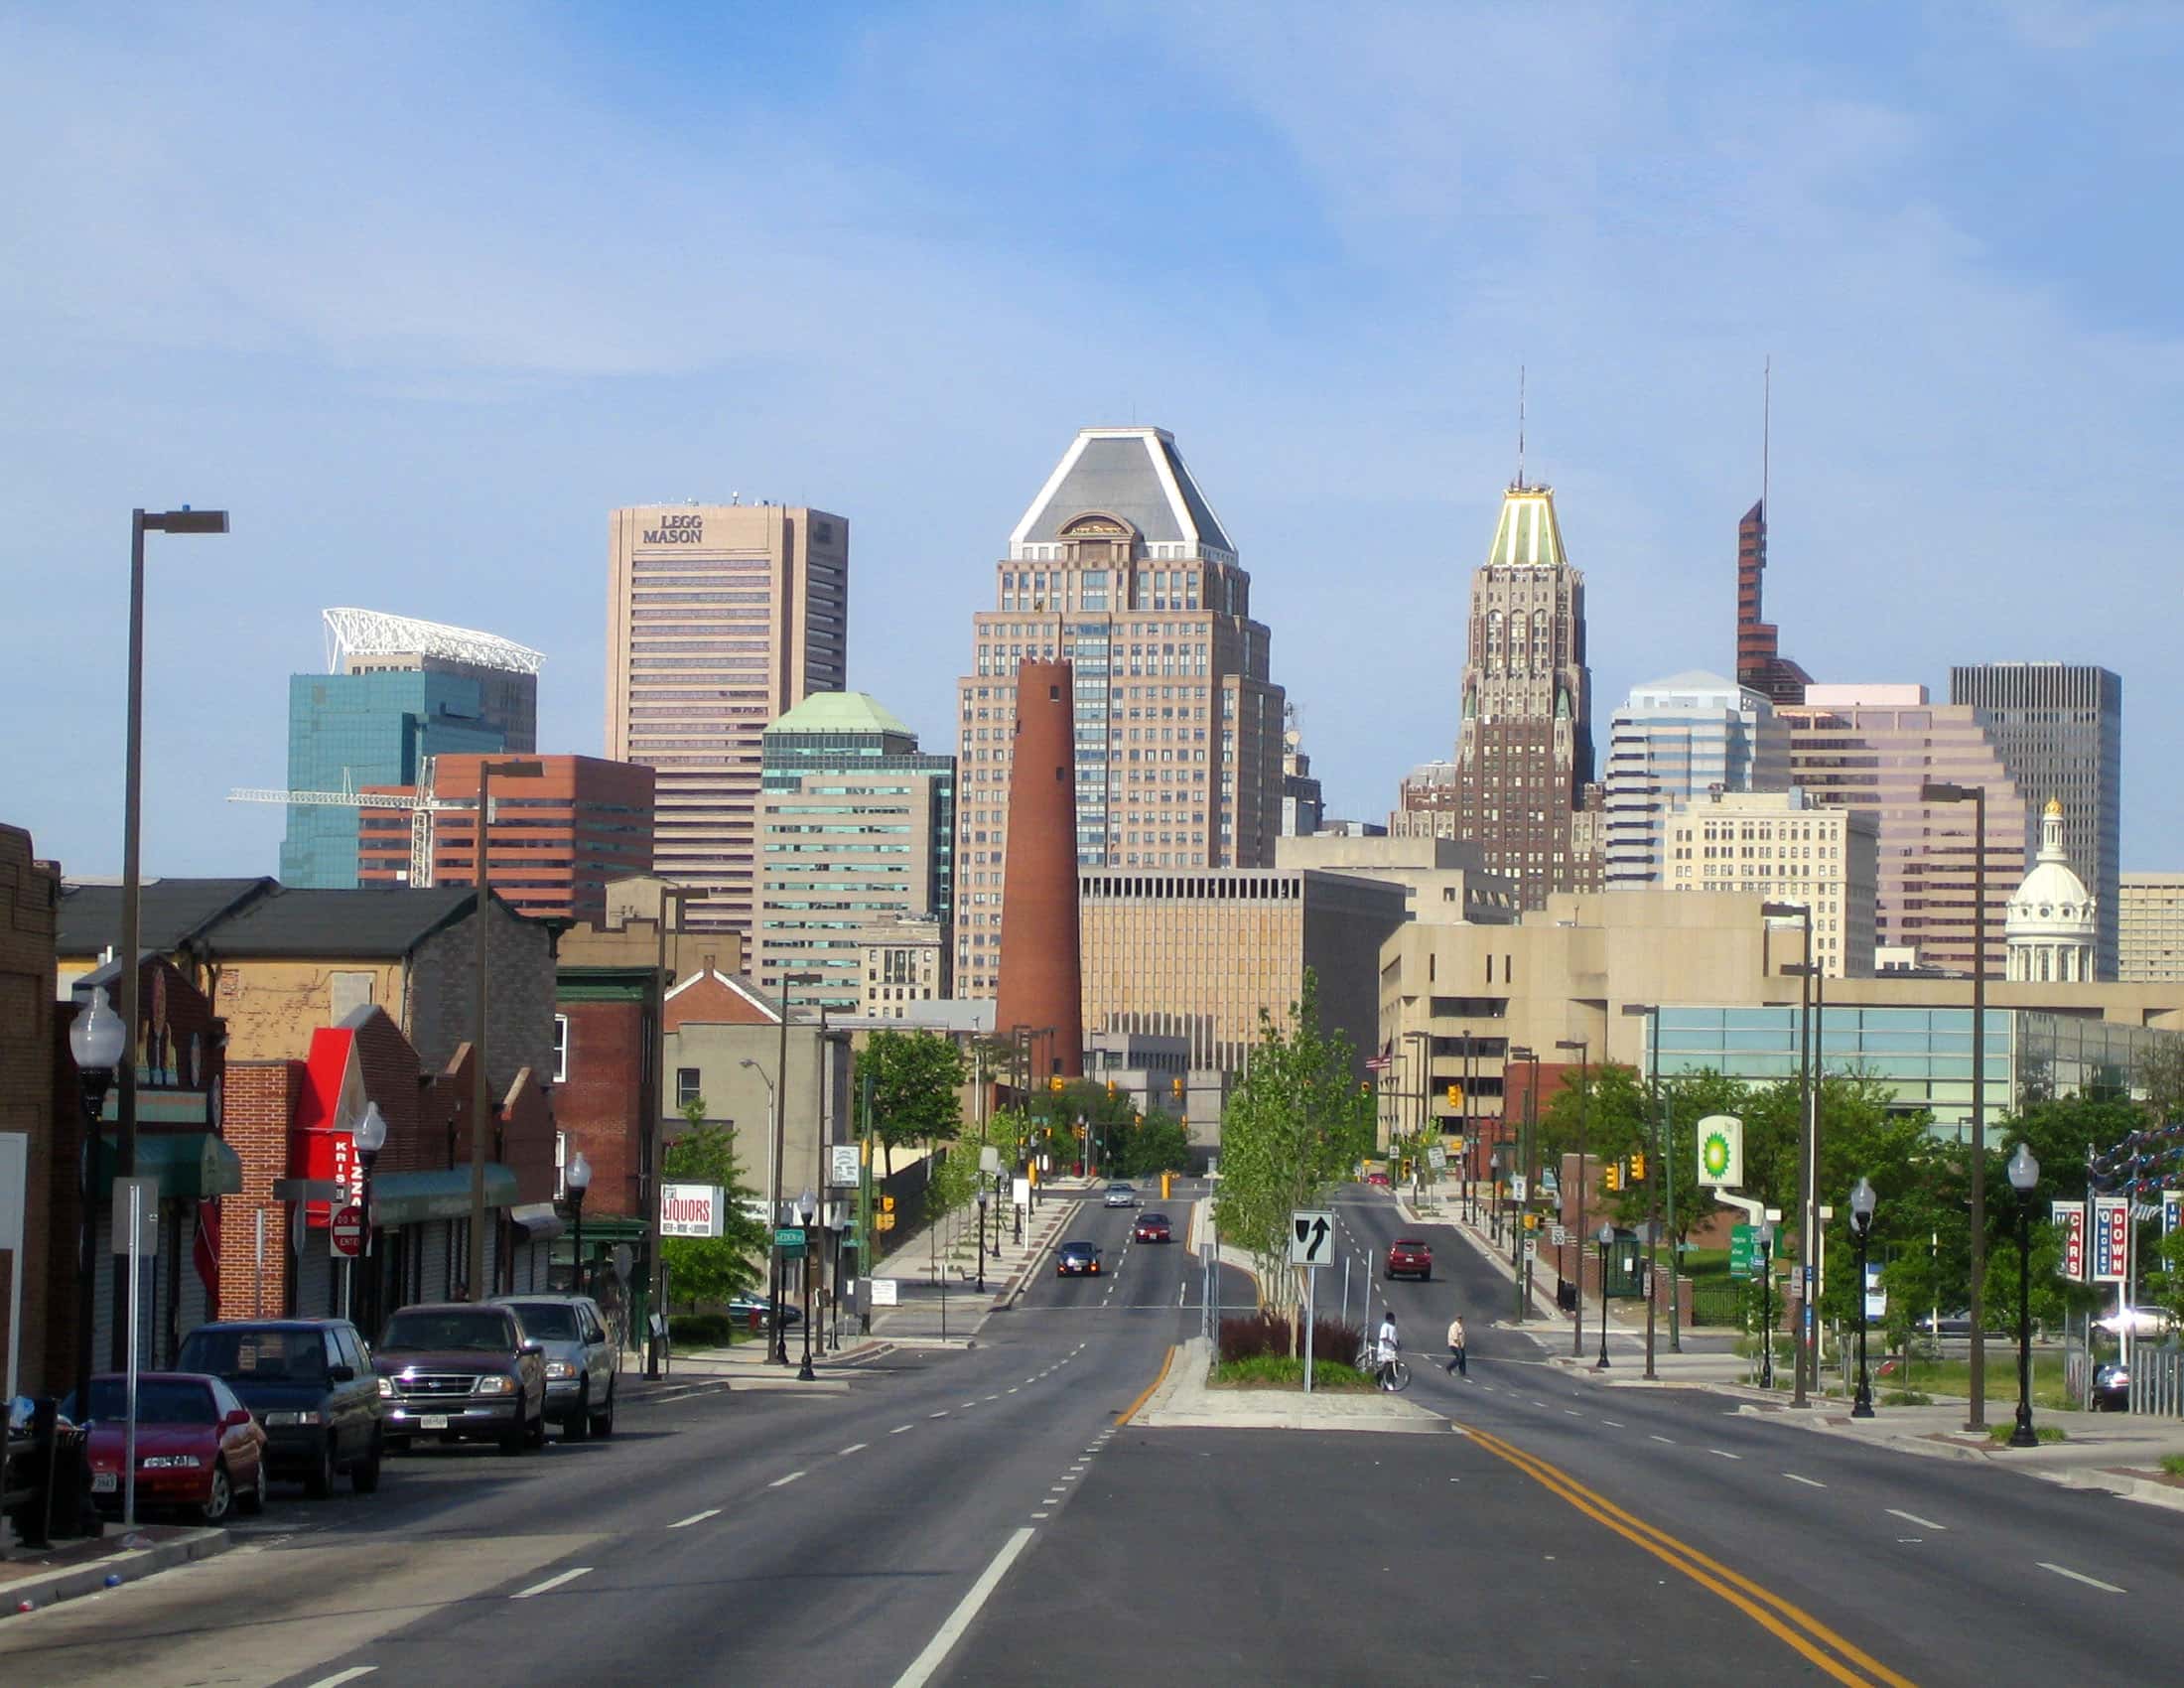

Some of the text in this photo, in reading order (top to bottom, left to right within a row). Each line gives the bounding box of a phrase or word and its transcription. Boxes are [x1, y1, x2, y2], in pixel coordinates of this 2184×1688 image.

[660, 515, 703, 529] LEGG
[643, 529, 703, 544] MASON
[662, 1198, 710, 1223] LIQUORS
[340, 1238, 358, 1247] ENTE
[2069, 1214, 2080, 1273] CARS
[2112, 1213, 2124, 1272] DOWN
